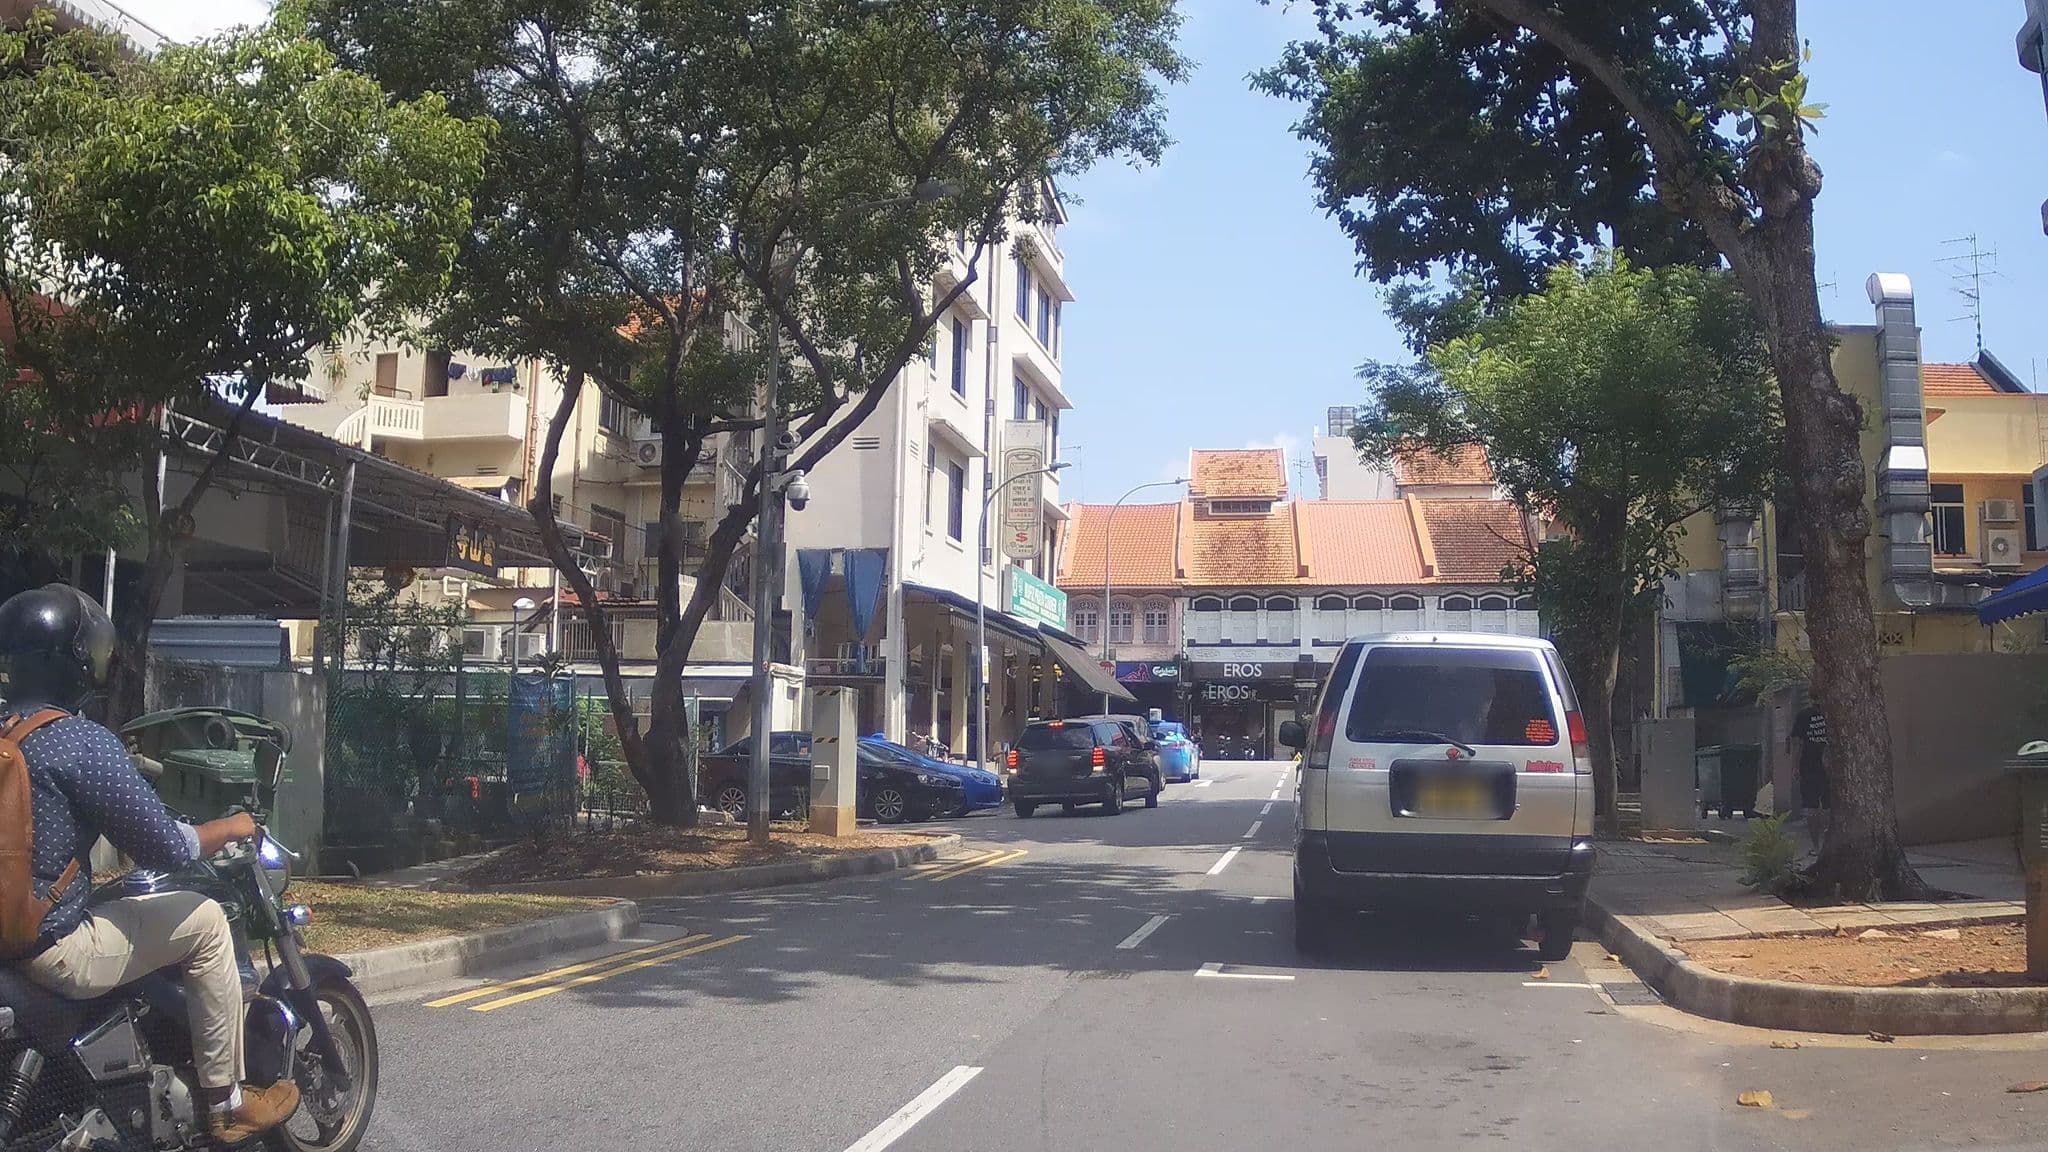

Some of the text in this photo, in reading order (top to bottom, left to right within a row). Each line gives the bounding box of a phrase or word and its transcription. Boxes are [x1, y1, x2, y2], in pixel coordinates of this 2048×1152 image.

[1153, 666, 1178, 677] Carlsberg
[1223, 663, 1262, 678] EROS
[1208, 685, 1249, 700] EROS
